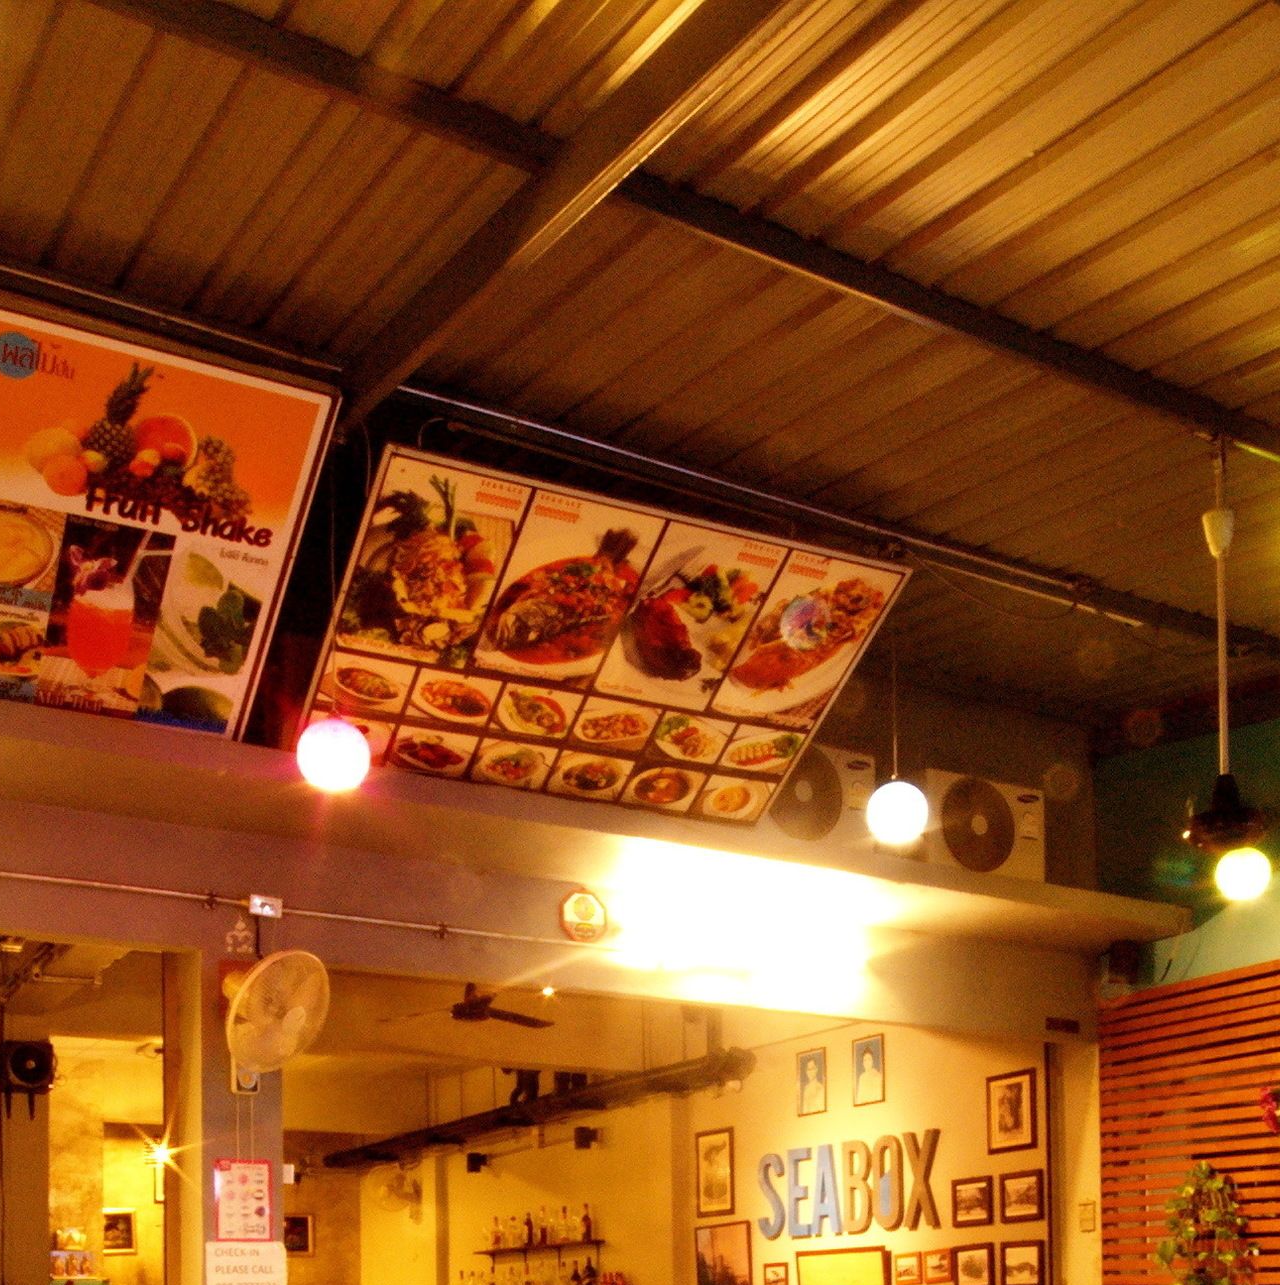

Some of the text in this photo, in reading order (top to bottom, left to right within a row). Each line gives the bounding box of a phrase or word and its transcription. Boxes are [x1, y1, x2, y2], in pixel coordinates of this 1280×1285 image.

[84, 486, 273, 548] Fruit Shake
[757, 1128, 942, 1241] SEABOX
[214, 1247, 260, 1258] CHECK-IN
[215, 1264, 274, 1275] PLEASE CALL
